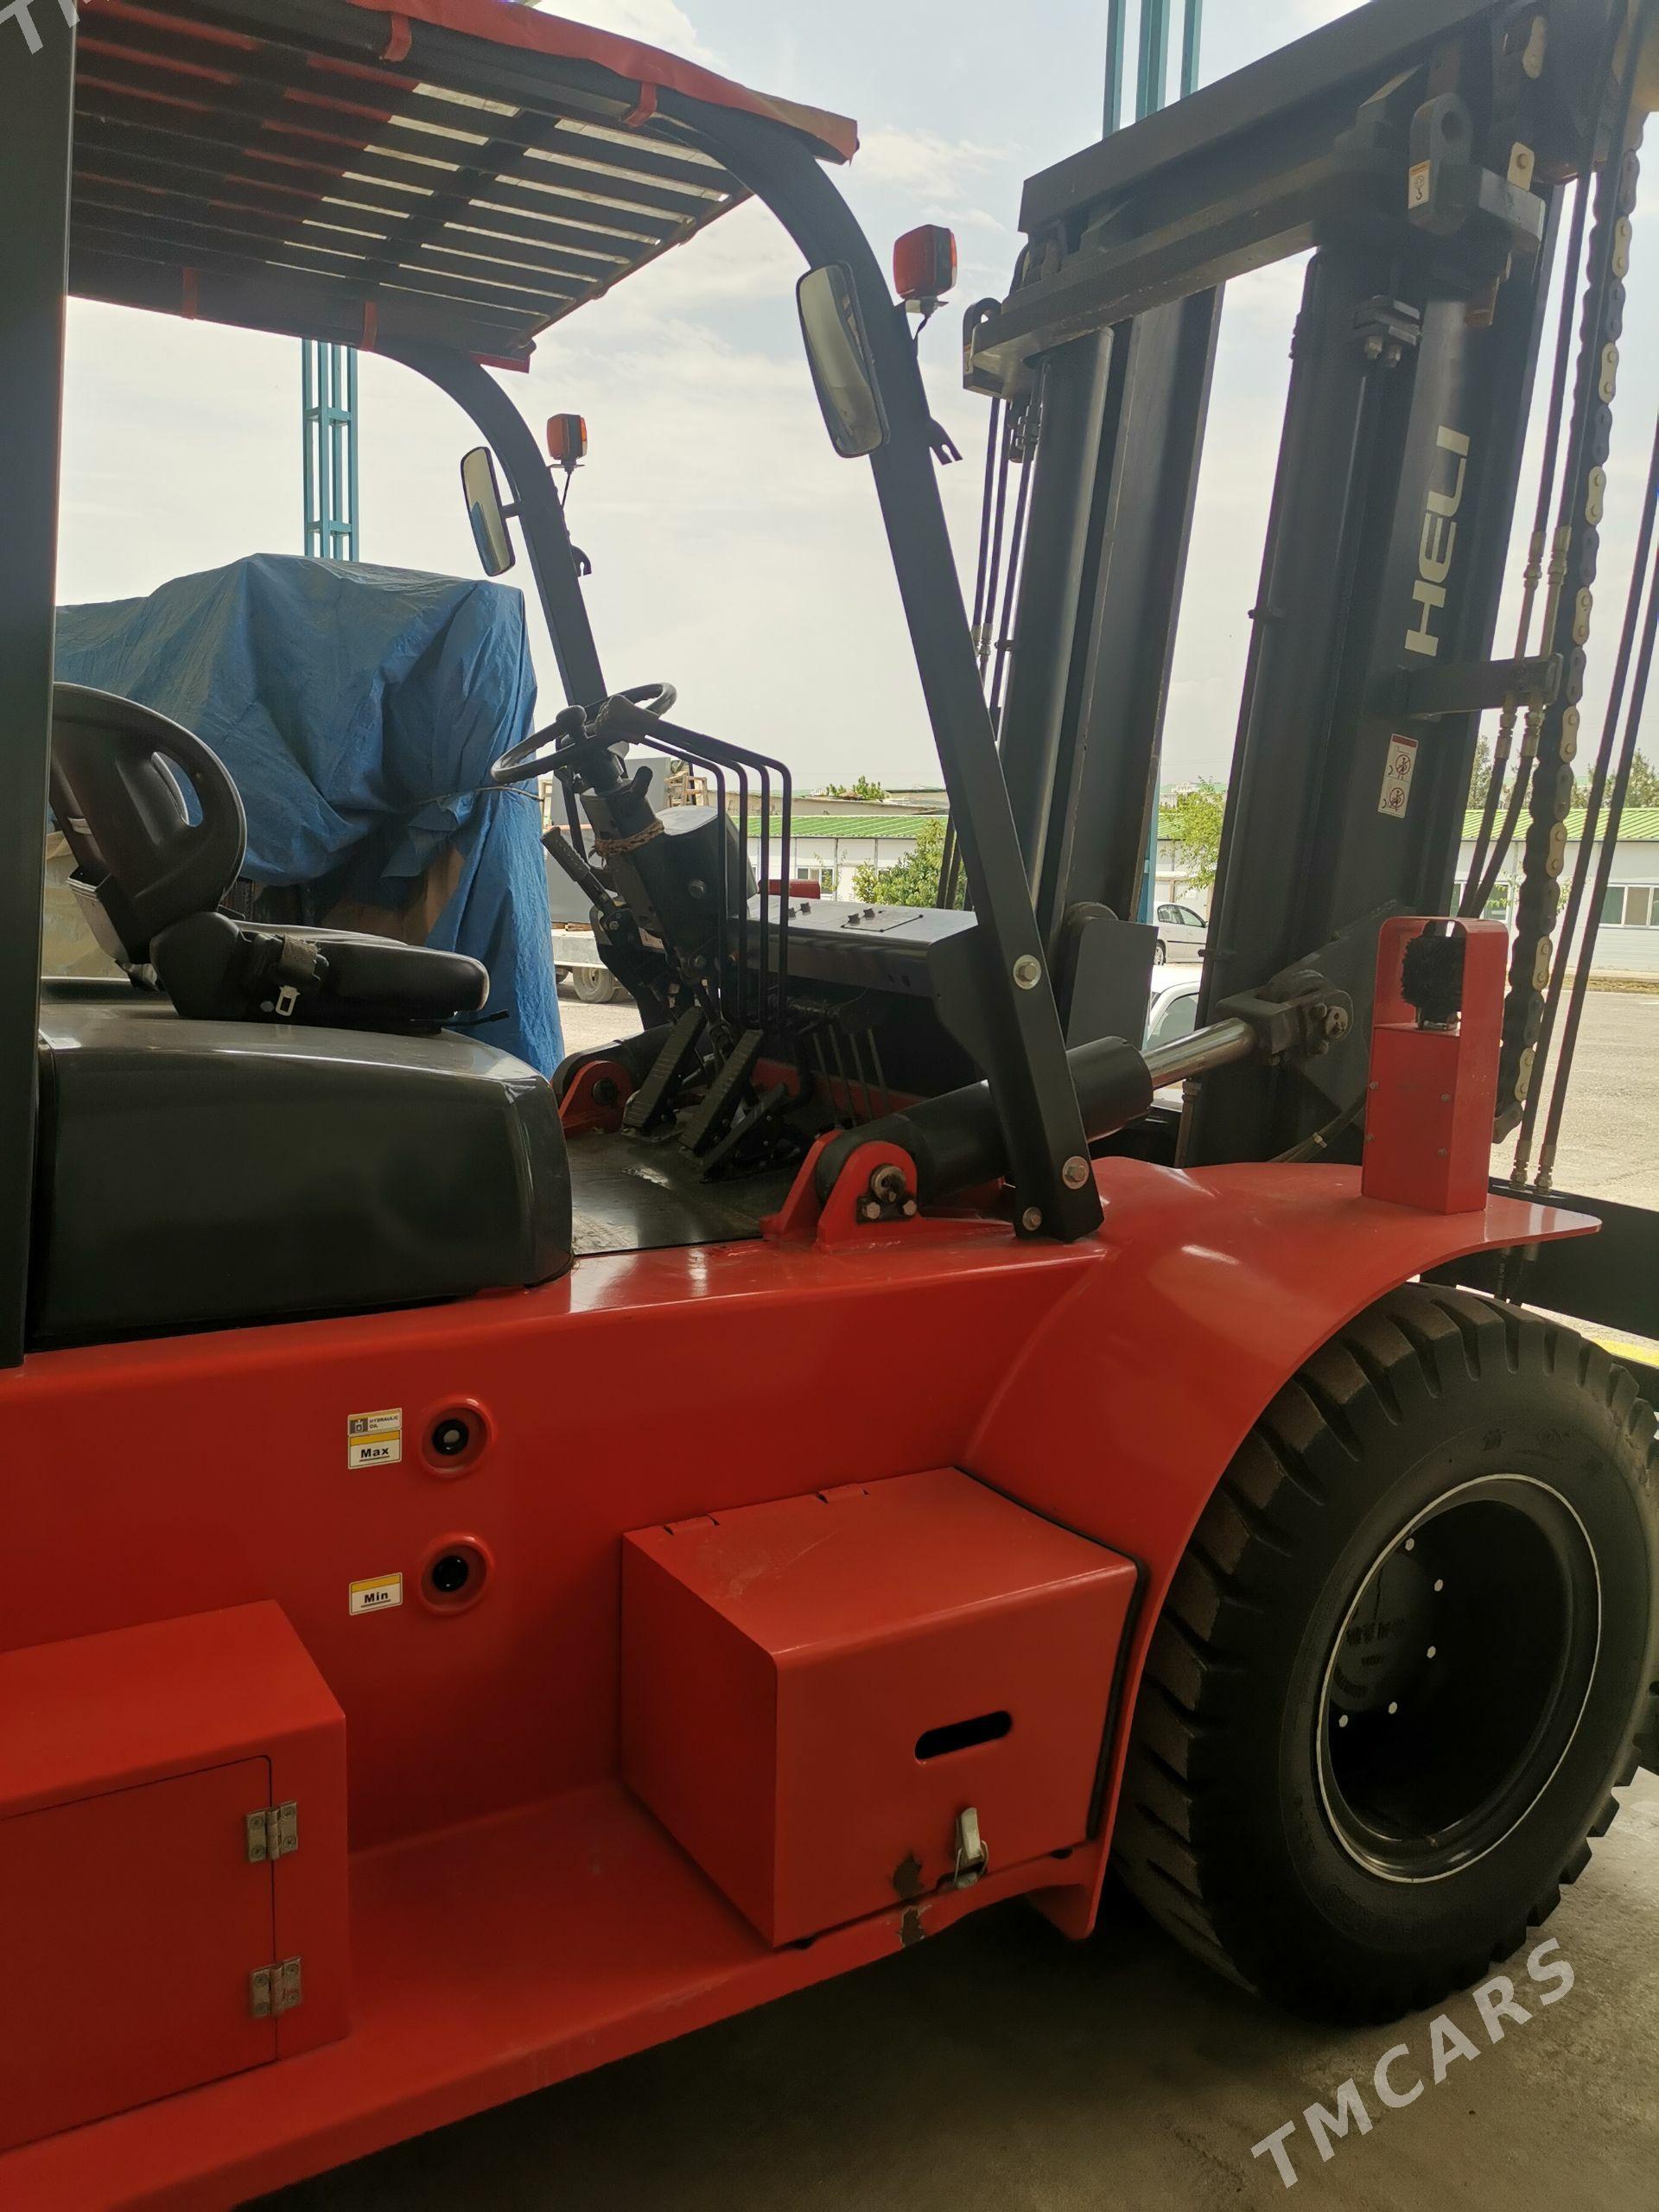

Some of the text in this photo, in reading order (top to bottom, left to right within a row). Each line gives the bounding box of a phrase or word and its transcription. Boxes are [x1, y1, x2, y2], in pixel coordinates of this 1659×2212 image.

[1404, 425, 1470, 657] HELI
[360, 1447, 390, 1459] Max
[364, 1592, 389, 1604] Min
